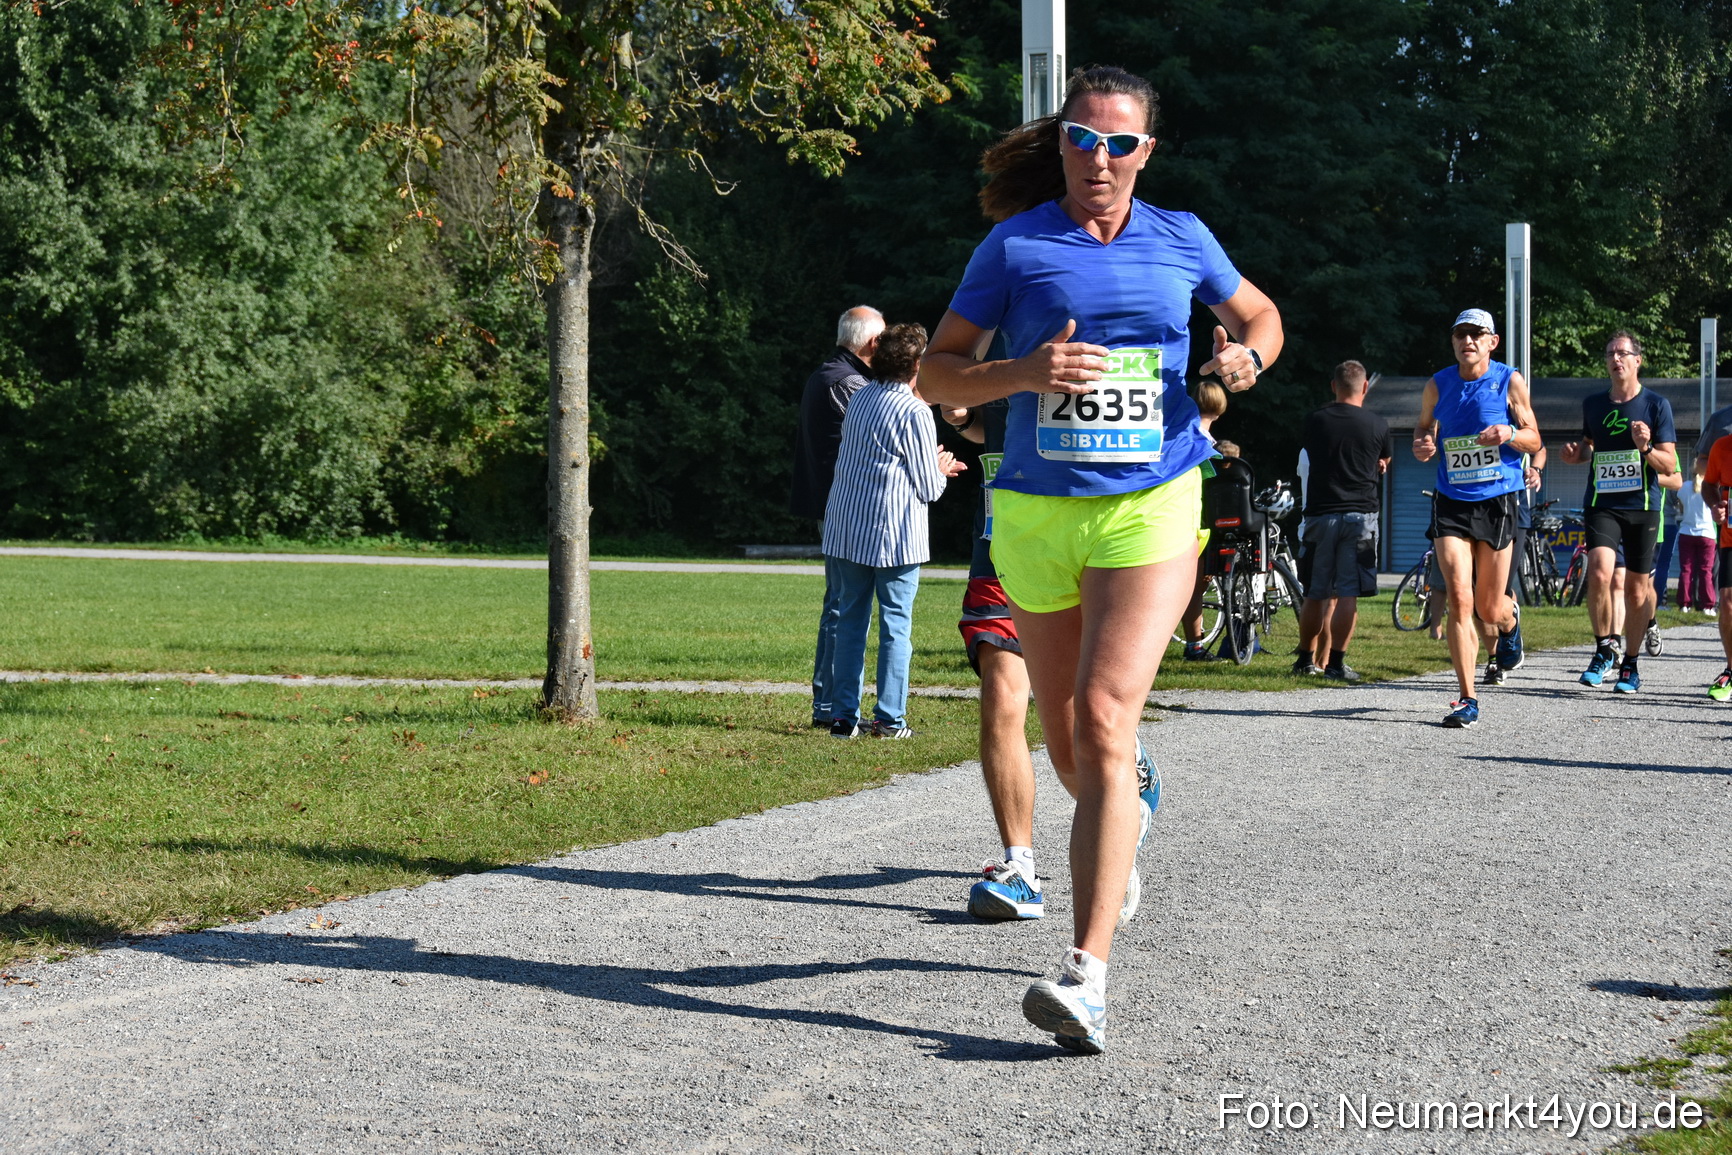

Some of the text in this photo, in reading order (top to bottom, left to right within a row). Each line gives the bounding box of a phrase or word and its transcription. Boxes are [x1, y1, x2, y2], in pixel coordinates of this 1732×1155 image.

[1051, 388, 1149, 422] 2635
[1060, 433, 1141, 448] SIBYLLE
[1451, 449, 1495, 469] 2015
[1597, 453, 1634, 462] BOCK
[1454, 468, 1495, 480] MANFRED
[1600, 464, 1636, 479] 2439
[1600, 480, 1637, 489] BERTHOLD
